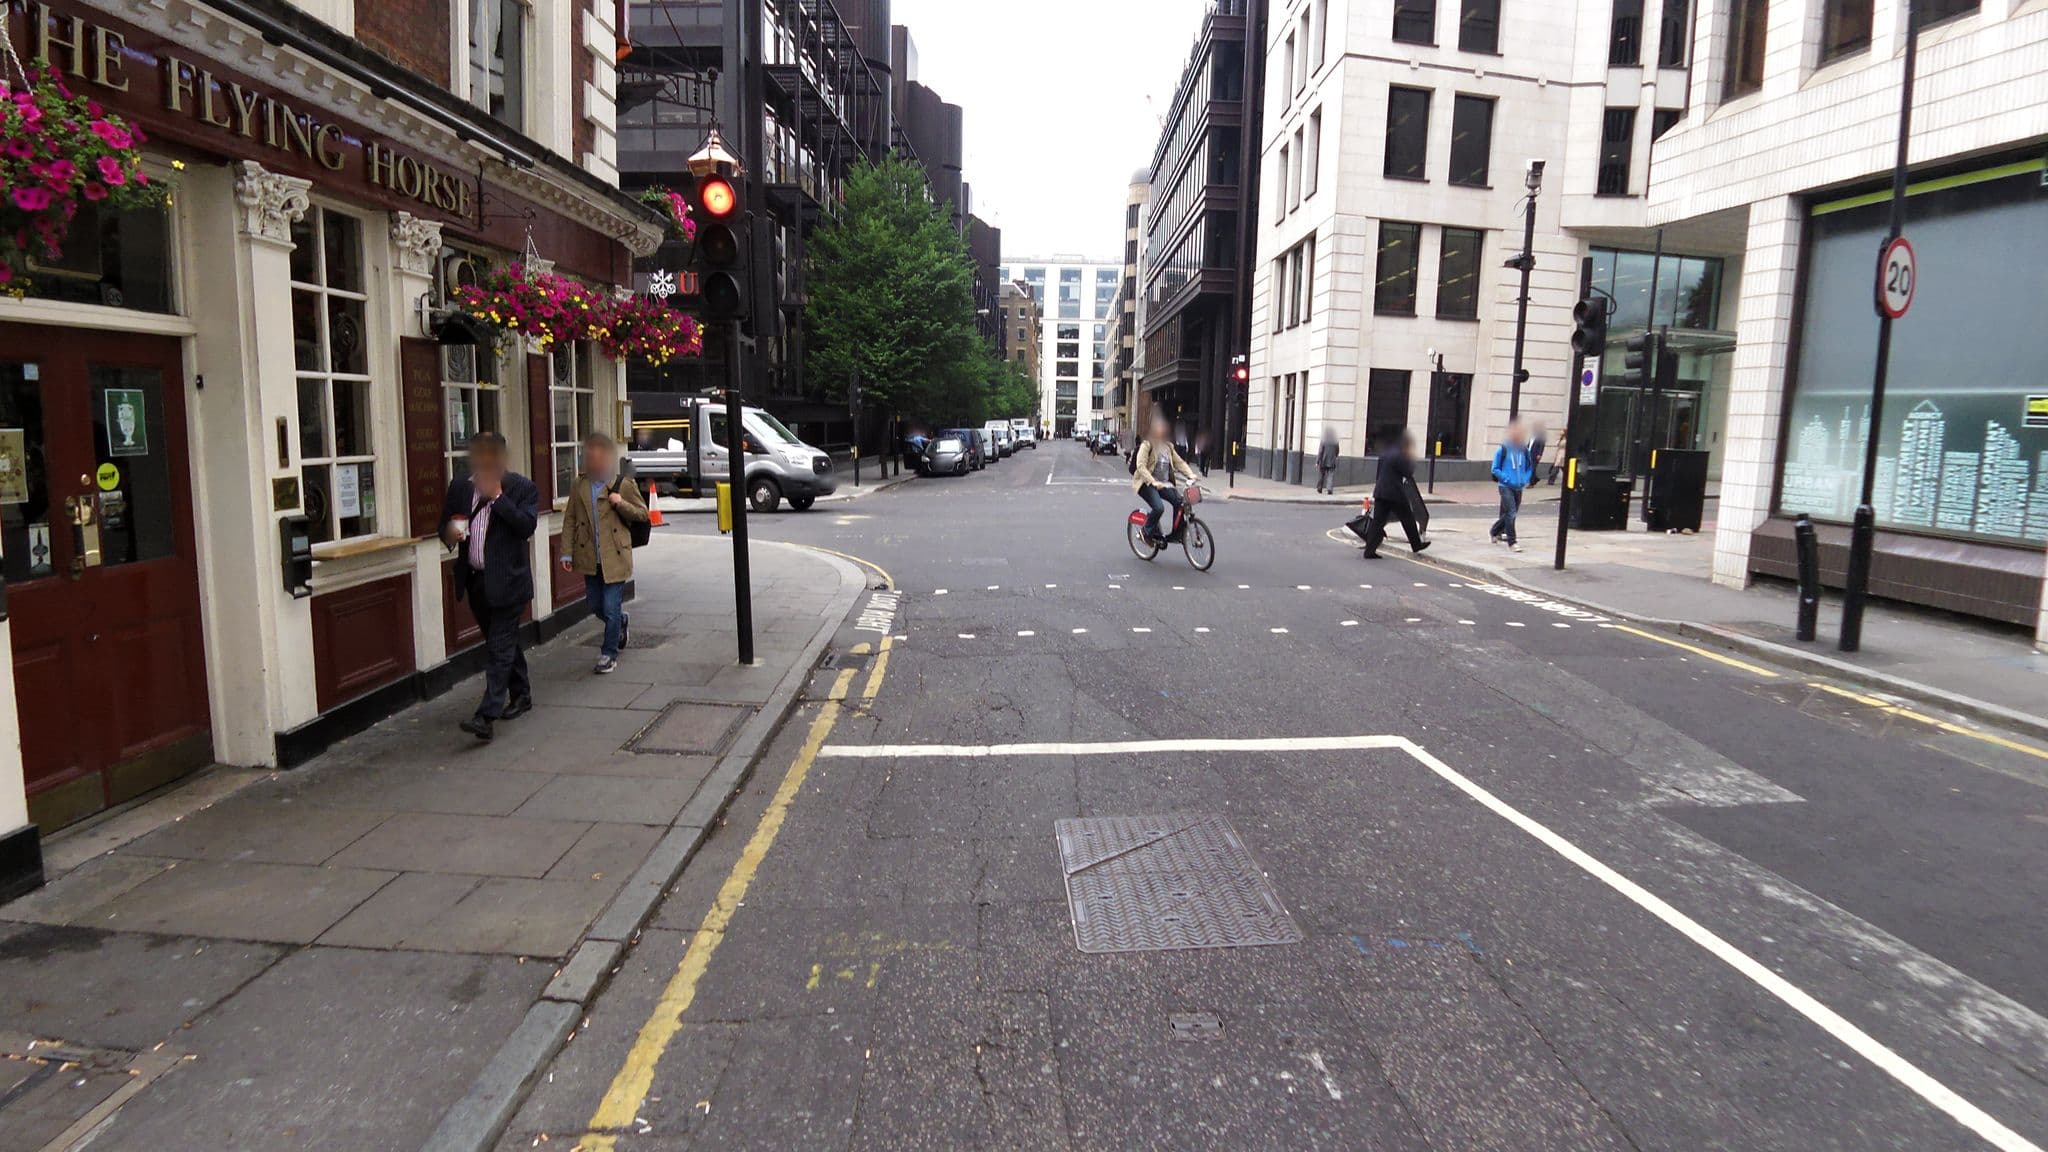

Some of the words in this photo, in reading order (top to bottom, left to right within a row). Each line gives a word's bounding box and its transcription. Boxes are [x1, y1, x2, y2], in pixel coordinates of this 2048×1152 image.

[167, 56, 345, 171] FLYING
[369, 140, 474, 219] HORSE
[1888, 261, 1911, 297] 20
[1892, 420, 1914, 523] INVESTMENT
[1910, 420, 1929, 506] VALUATIONS
[1931, 420, 1946, 478] ACQUISITION
[1975, 420, 1999, 534] DEVELOPMENT
[2014, 480, 2029, 526] RETAIL
[1927, 480, 1938, 527] PROPERTY
[854, 608, 895, 634] RIGHT
[865, 593, 900, 609] LOOK
